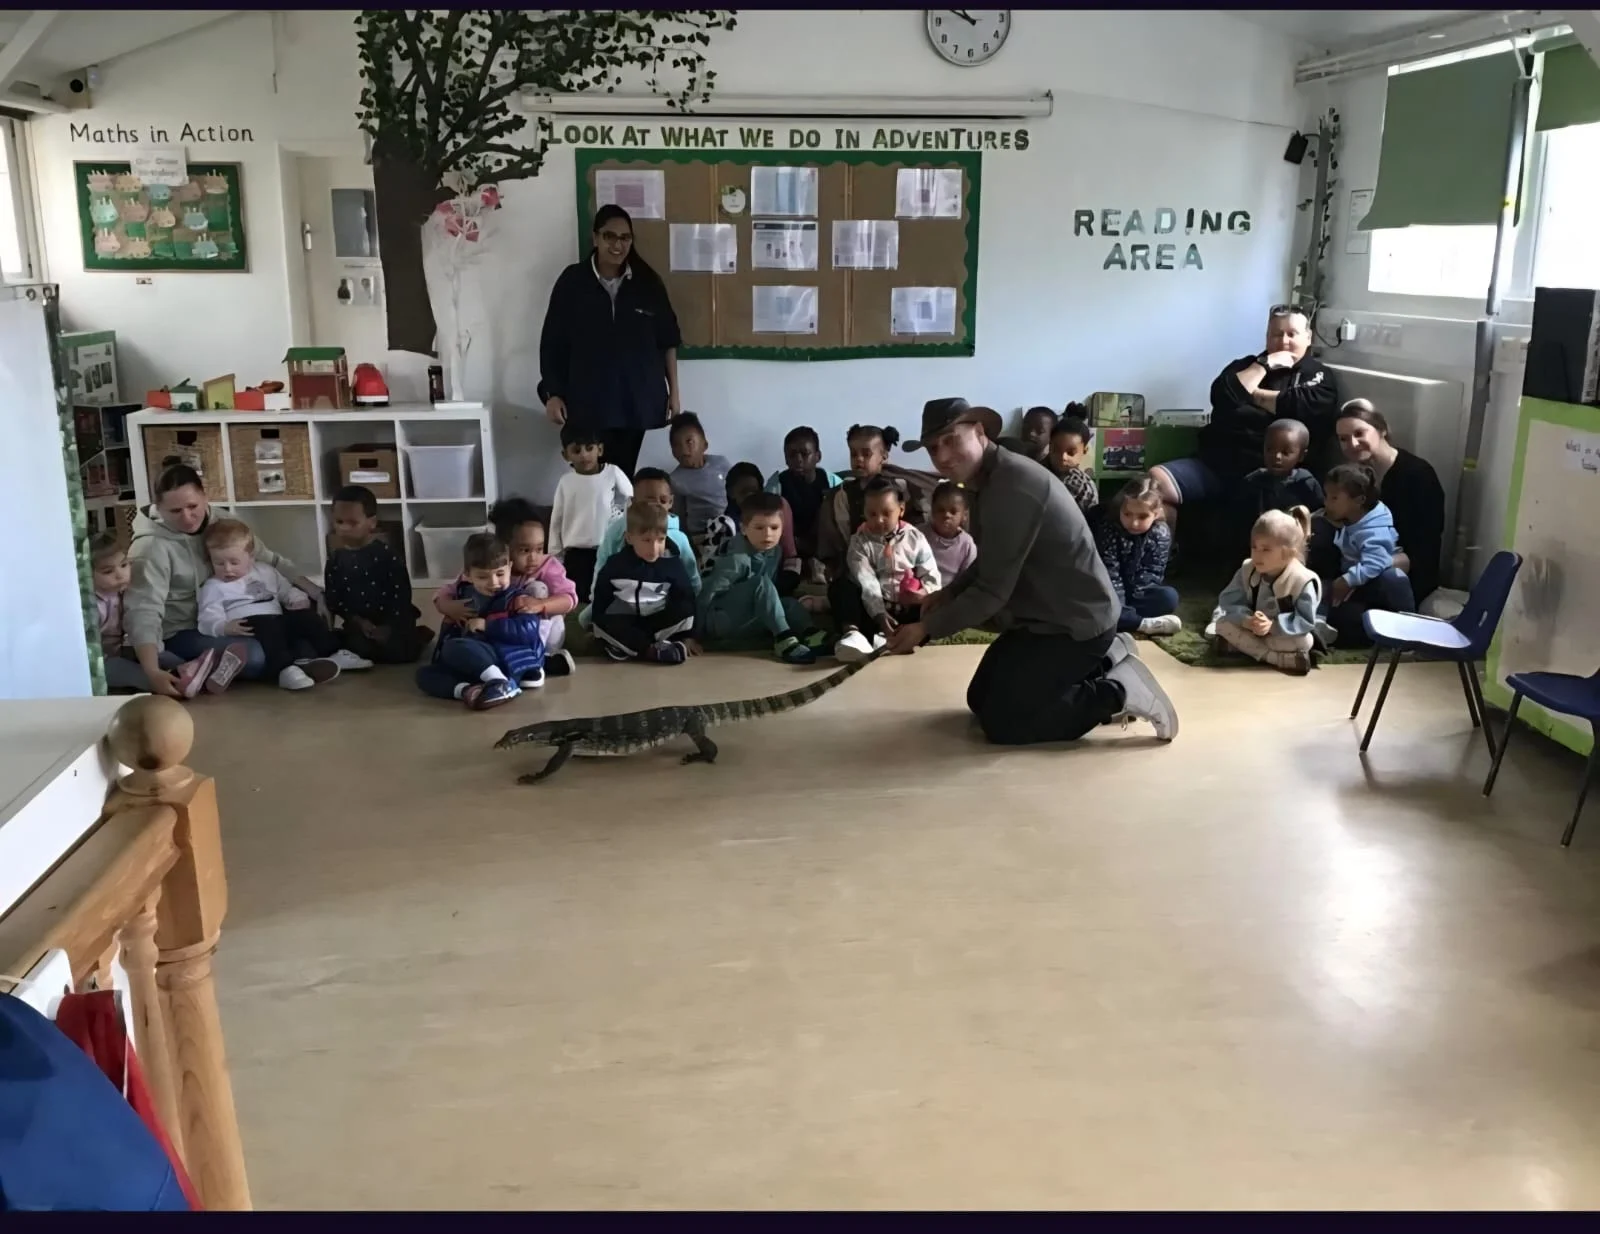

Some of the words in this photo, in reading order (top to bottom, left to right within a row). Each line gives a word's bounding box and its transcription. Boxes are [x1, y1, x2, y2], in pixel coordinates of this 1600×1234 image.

[993, 30, 999, 39] 4
[953, 44, 958, 54] 7
[968, 48, 974, 58] 6
[70, 122, 139, 143] Maths
[150, 125, 169, 143] in
[180, 122, 254, 142] Action
[548, 121, 614, 145] LOOK
[622, 125, 650, 146] AT
[660, 126, 728, 147] WHAT
[739, 127, 774, 148] WE
[789, 128, 821, 148] DO
[835, 128, 860, 149] IN
[872, 128, 1029, 150] ADVENTURES
[1074, 207, 1251, 237] READING
[1103, 243, 1203, 270] AREA
